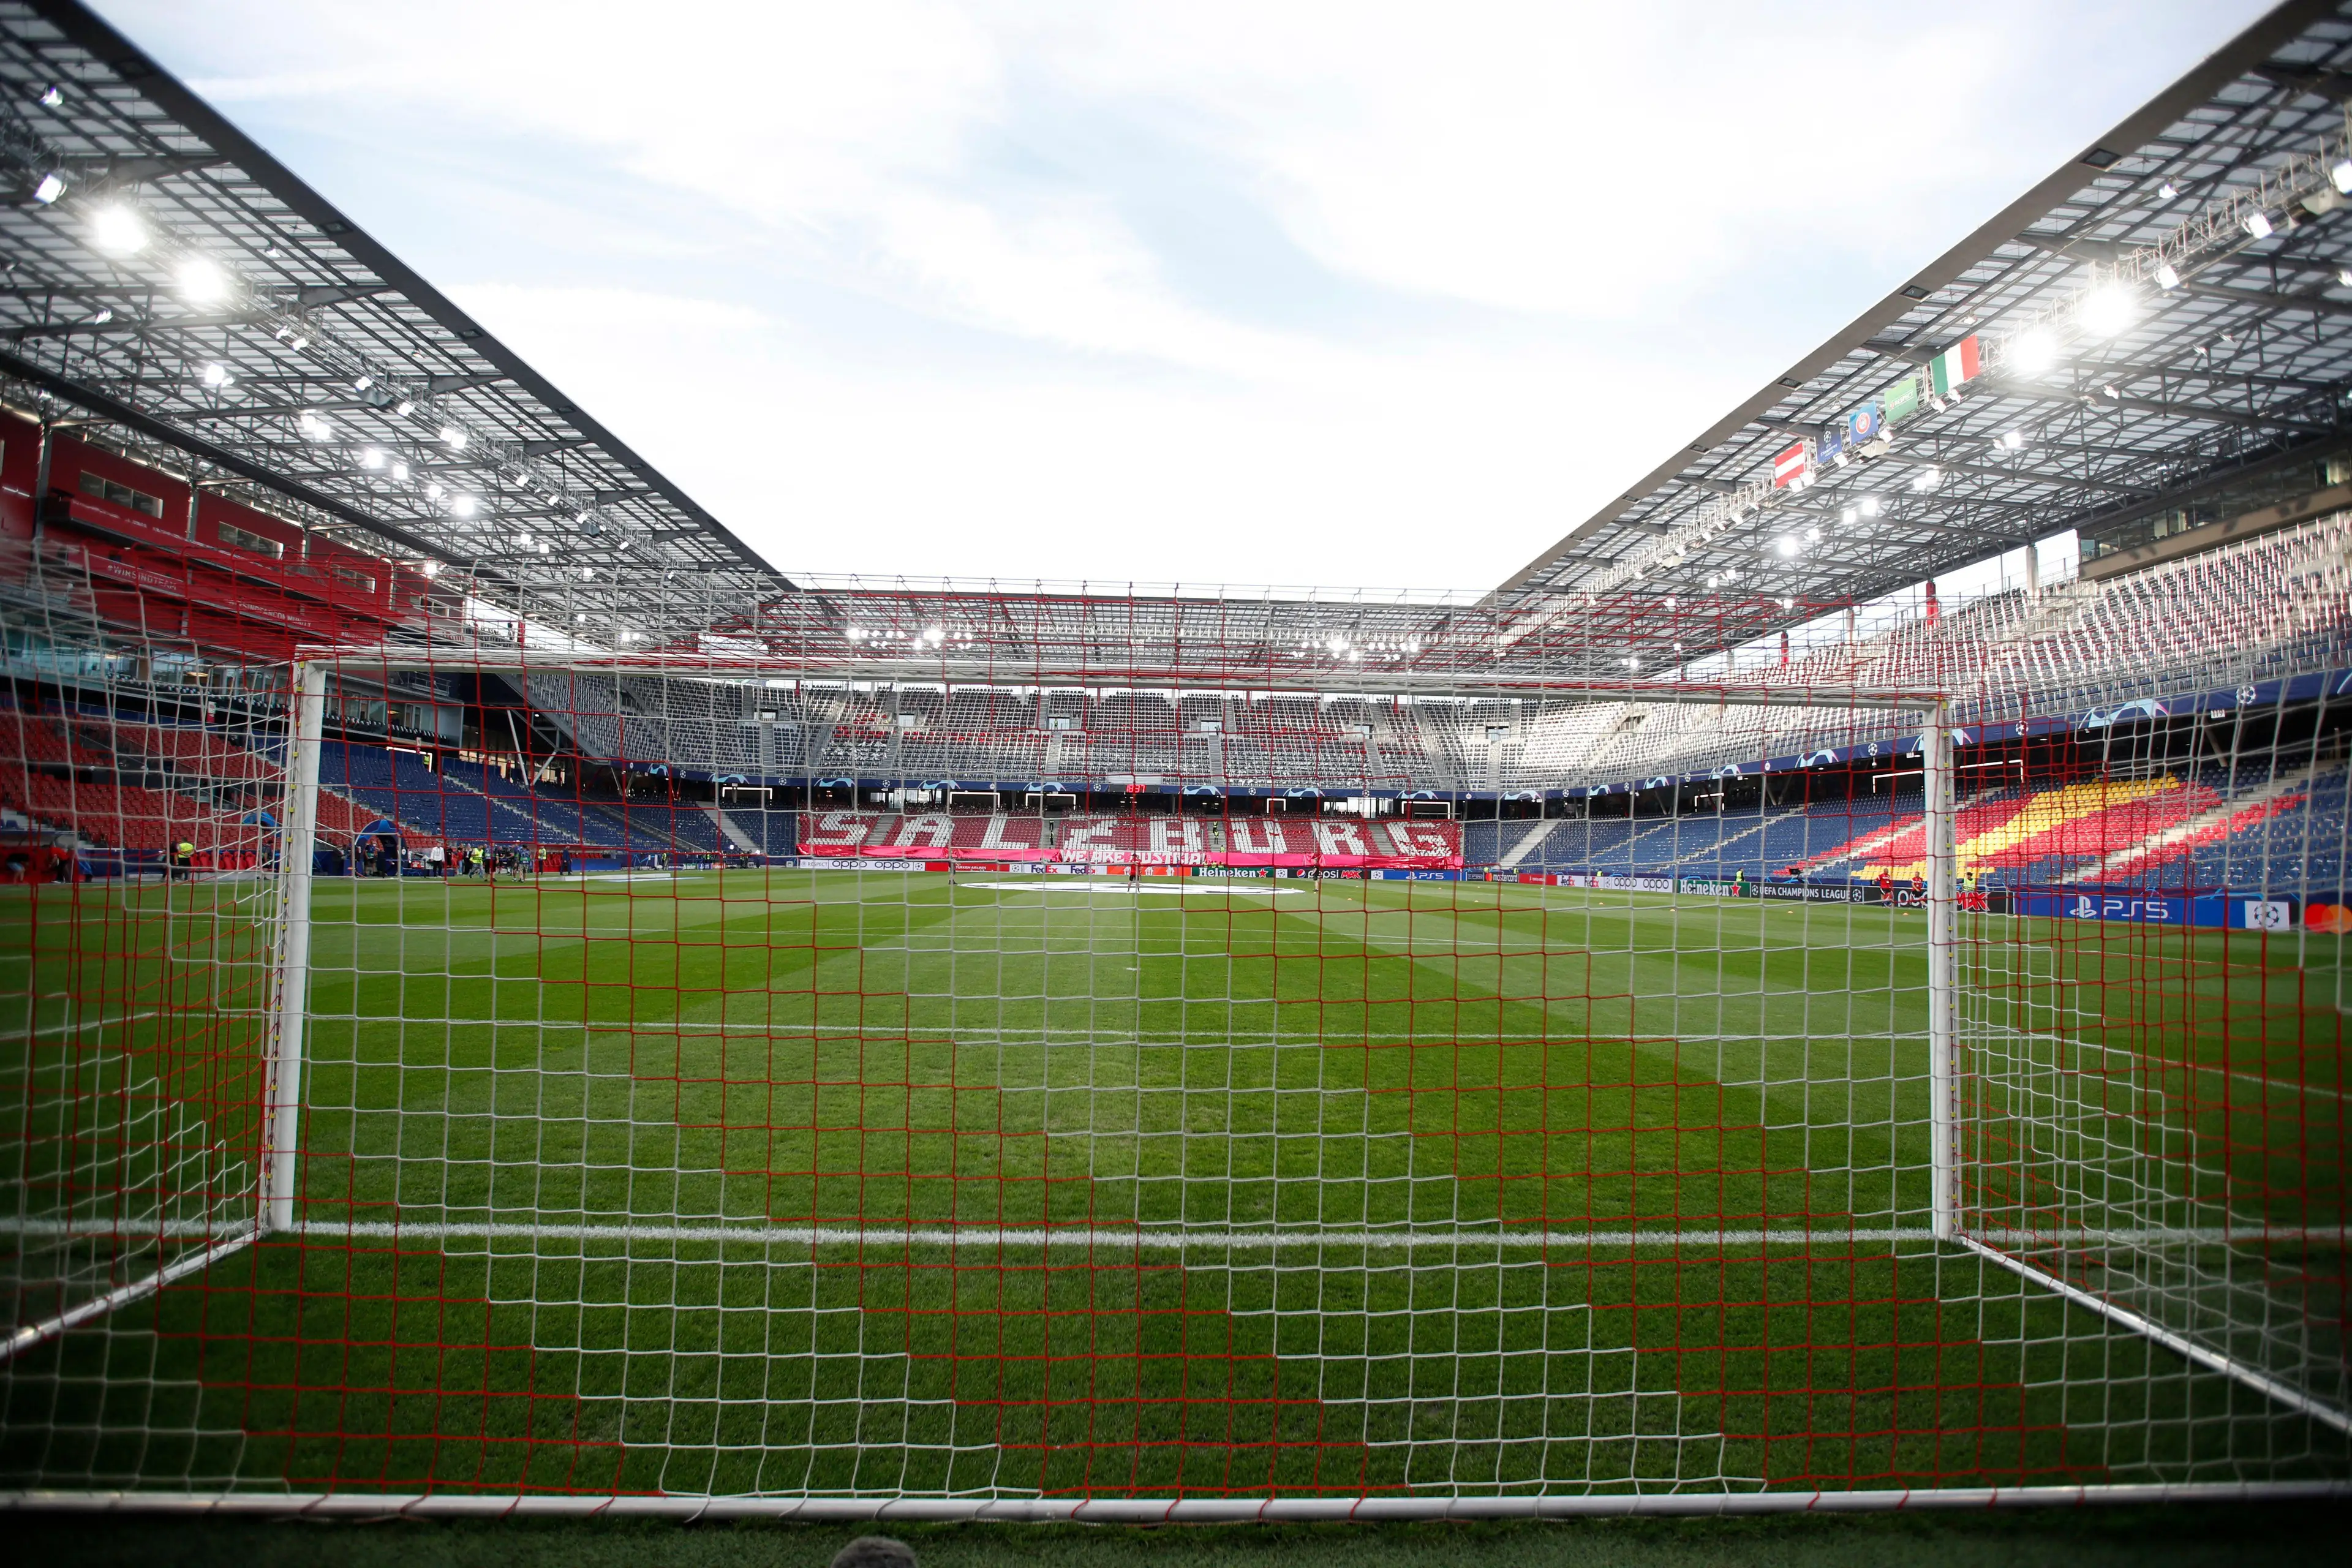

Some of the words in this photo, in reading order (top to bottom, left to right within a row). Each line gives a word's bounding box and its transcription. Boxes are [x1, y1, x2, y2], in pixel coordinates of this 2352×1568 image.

[1060, 850, 1087, 862] WE
[1031, 865, 1058, 873] FedEx
[1071, 865, 1096, 874] FedEx
[1199, 867, 1256, 878] Heineken
[1341, 870, 1362, 879] MAX
[1493, 873, 1518, 882] mastercard
[1680, 879, 1730, 896] Heineken
[1760, 886, 1776, 895] UEFA
[1778, 887, 1819, 898] CHAMPIONS
[1821, 889, 1850, 900] LEAGUE
[2103, 900, 2169, 919] PS5
